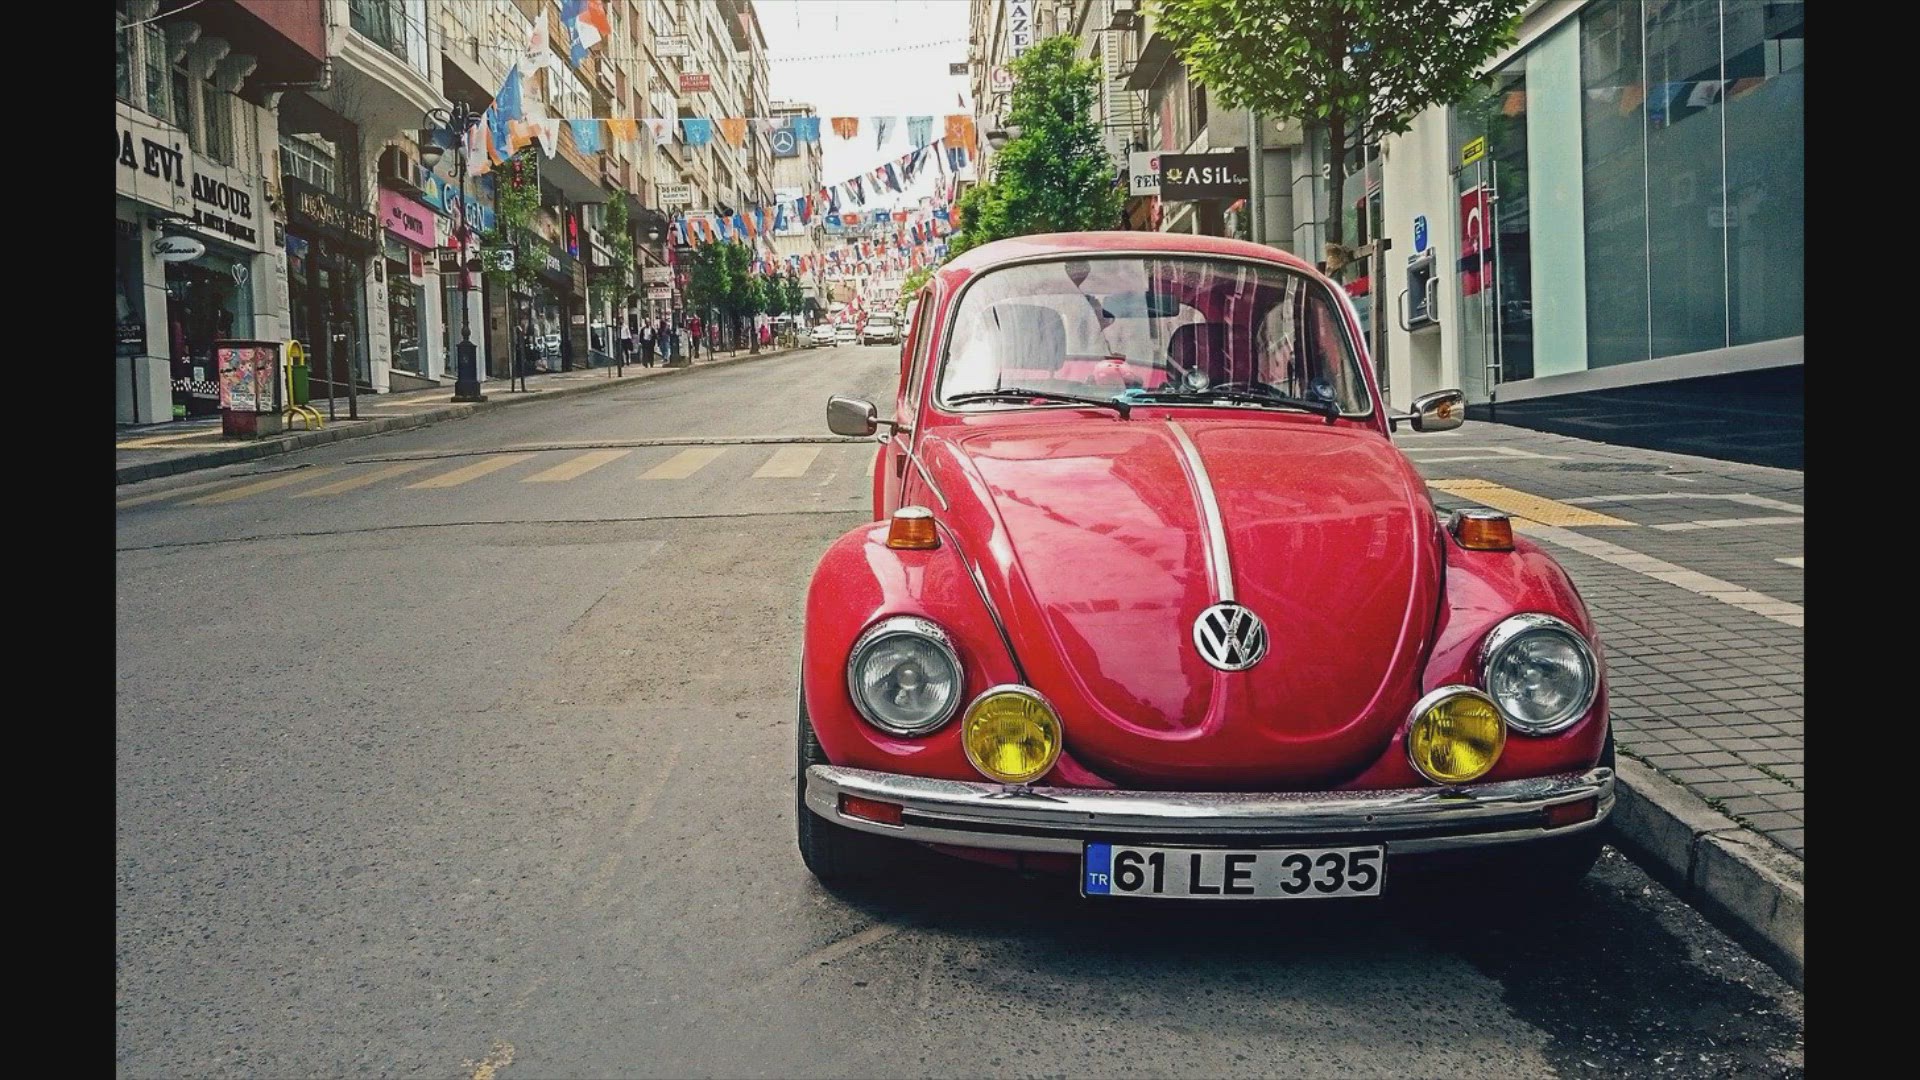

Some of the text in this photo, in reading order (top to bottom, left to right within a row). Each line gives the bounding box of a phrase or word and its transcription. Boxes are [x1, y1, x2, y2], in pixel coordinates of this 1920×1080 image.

[1011, 0, 1029, 57] AZE
[141, 136, 185, 187] EVİ
[191, 172, 252, 220] AMOUR
[1089, 850, 1380, 895] TR 61 LE 335
